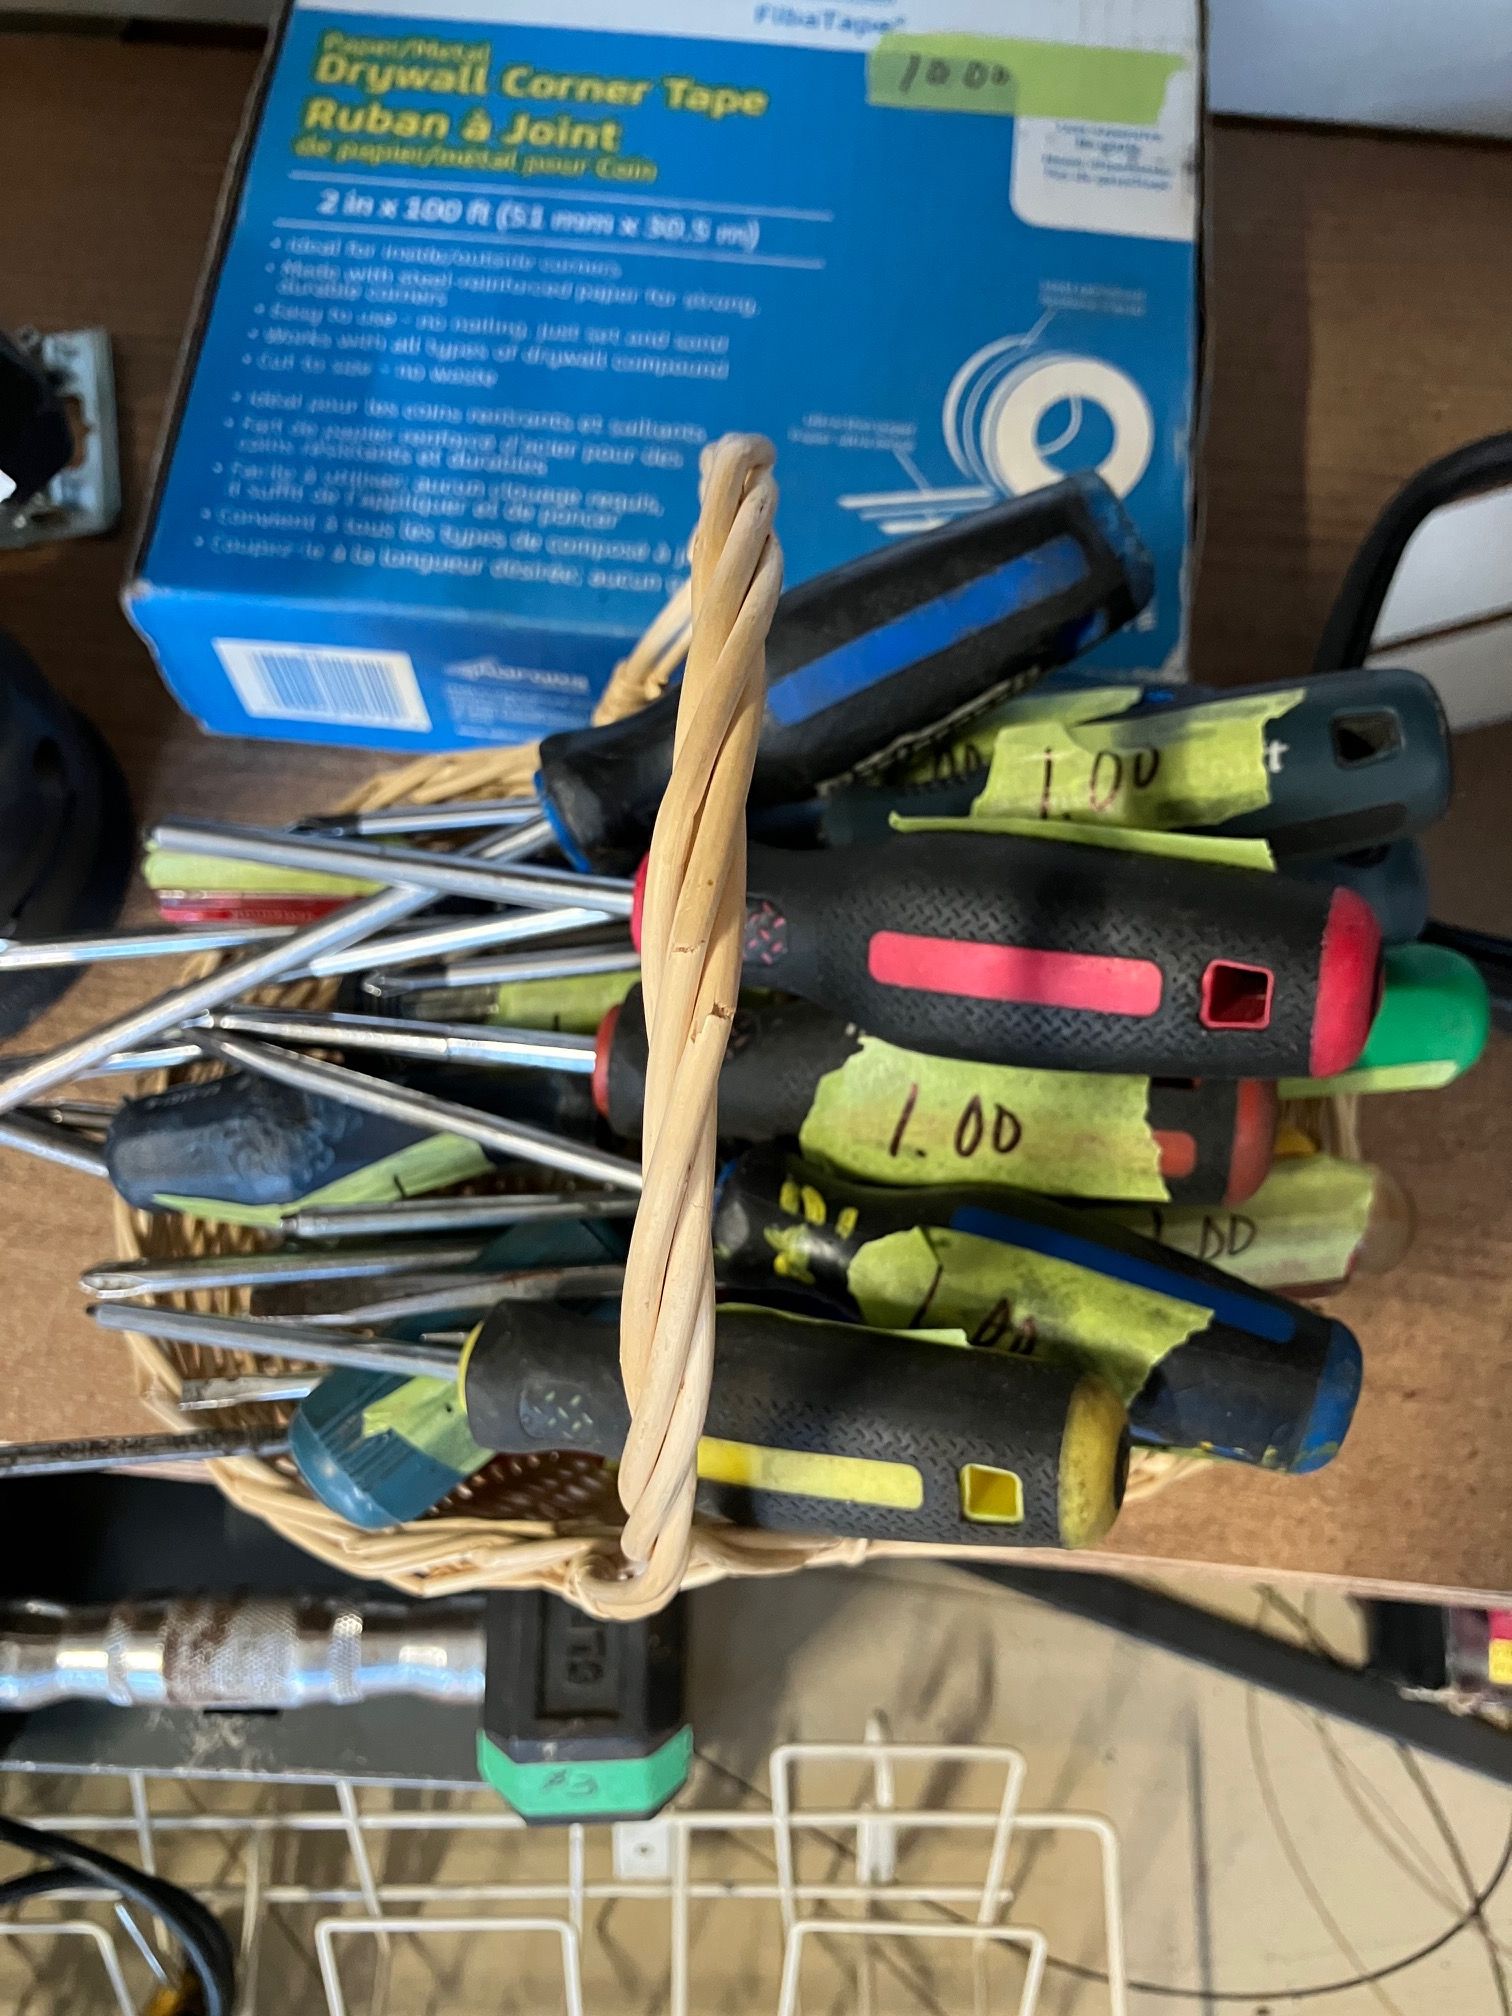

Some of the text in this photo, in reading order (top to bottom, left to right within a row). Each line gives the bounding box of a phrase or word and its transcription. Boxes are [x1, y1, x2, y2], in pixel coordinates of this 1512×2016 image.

[316, 54, 768, 119] Drywall Corner Tape
[305, 97, 620, 152] Ruban à Joint
[317, 188, 760, 253] 2 in x 100 ft (51 mm x 30.5 m)
[888, 1083, 1022, 1158] 1.00
